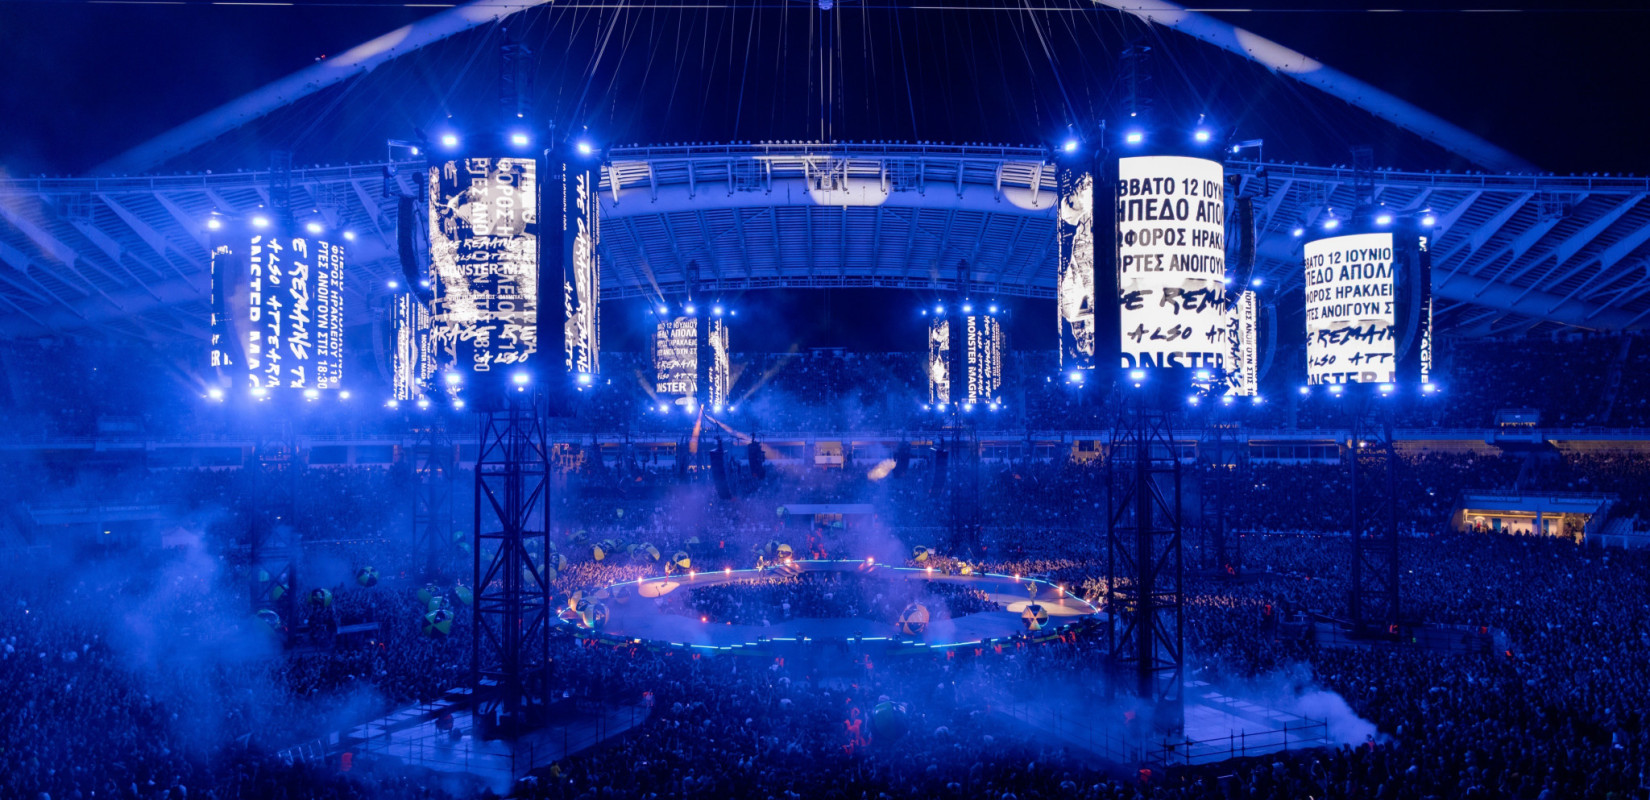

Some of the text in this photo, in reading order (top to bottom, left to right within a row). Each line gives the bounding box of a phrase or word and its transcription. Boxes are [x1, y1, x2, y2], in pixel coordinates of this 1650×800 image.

[576, 174, 586, 215] THE
[1182, 178, 1198, 196] 12
[267, 238, 283, 284] ALSO
[576, 218, 588, 302] GARAGE
[1328, 251, 1342, 264] 12
[288, 262, 312, 360] REMAINS
[318, 240, 329, 389] ΡΤΕΣ ΑΝΟΙΓΟΥΝ ΣΤΙΣ 18:30
[1321, 302, 1380, 318] ΑΝΟΙΓΟΥΝ
[1127, 324, 1192, 344] ALSO
[968, 316, 977, 404] MONSTER MAGNE
